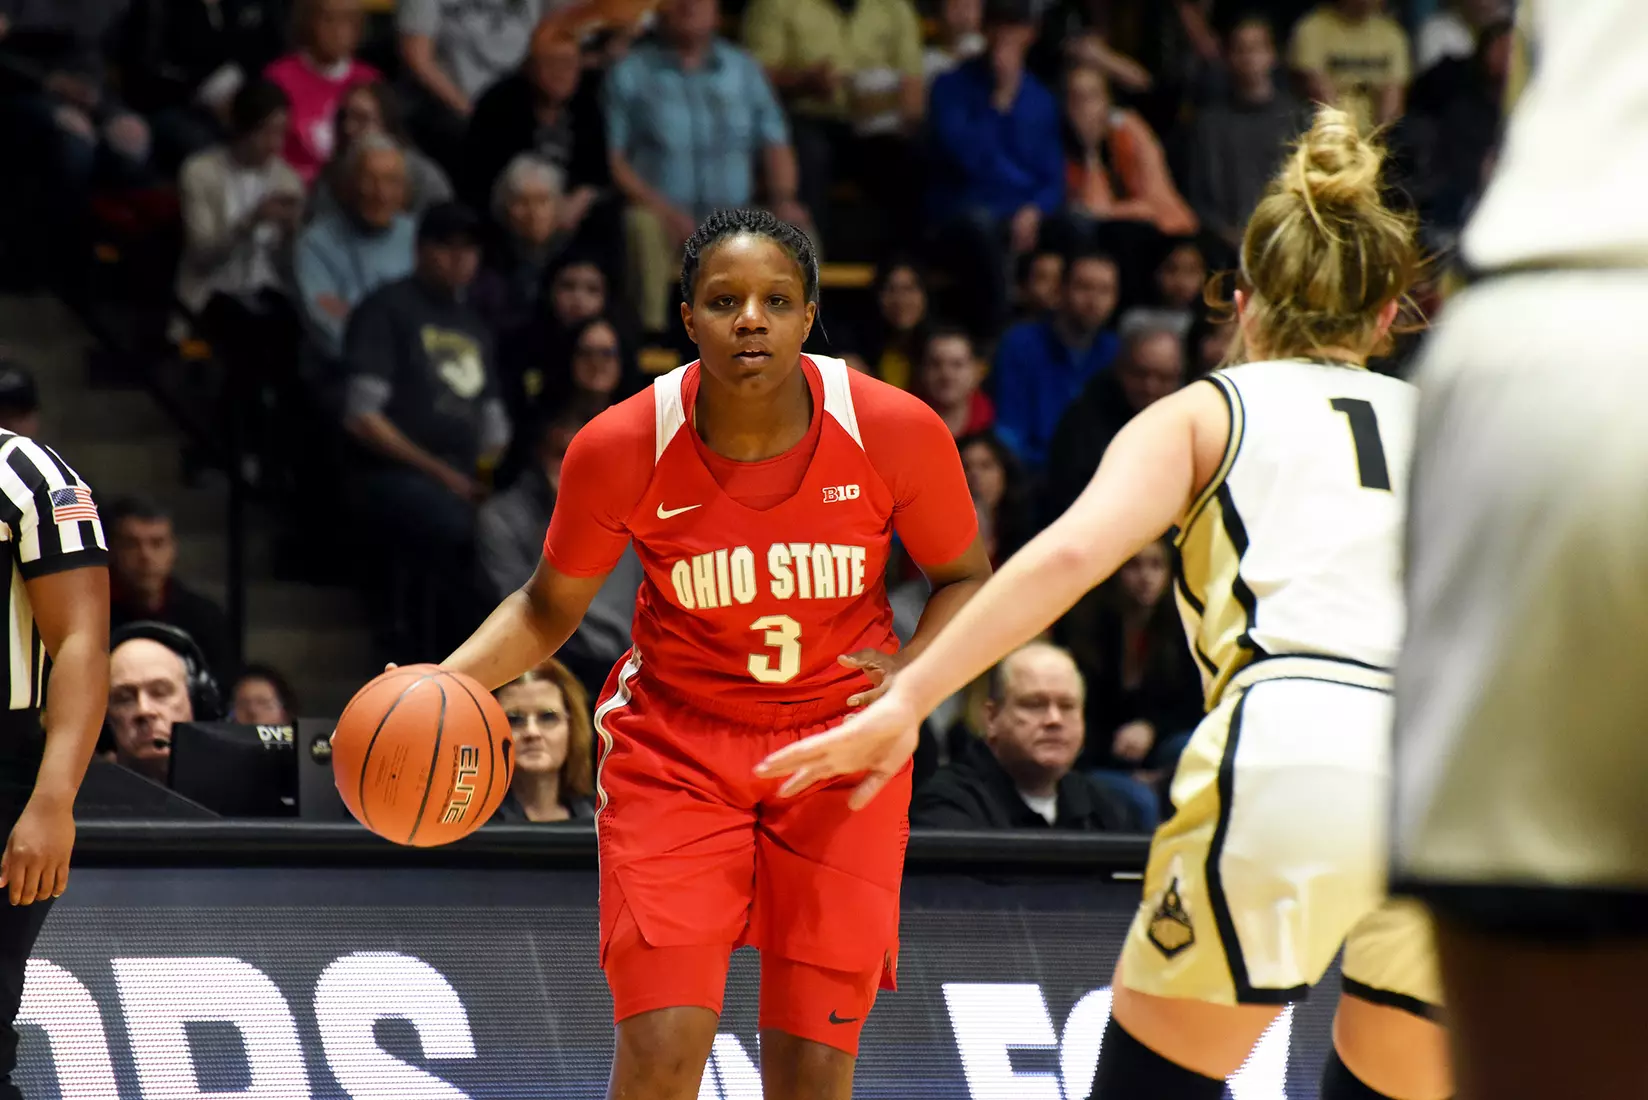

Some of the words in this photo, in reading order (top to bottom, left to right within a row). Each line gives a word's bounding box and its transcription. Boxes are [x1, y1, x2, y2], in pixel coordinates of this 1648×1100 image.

[1327, 397, 1392, 492] 1
[671, 545, 757, 609] OHIO
[767, 542, 866, 600] STATE
[747, 614, 802, 684] 3
